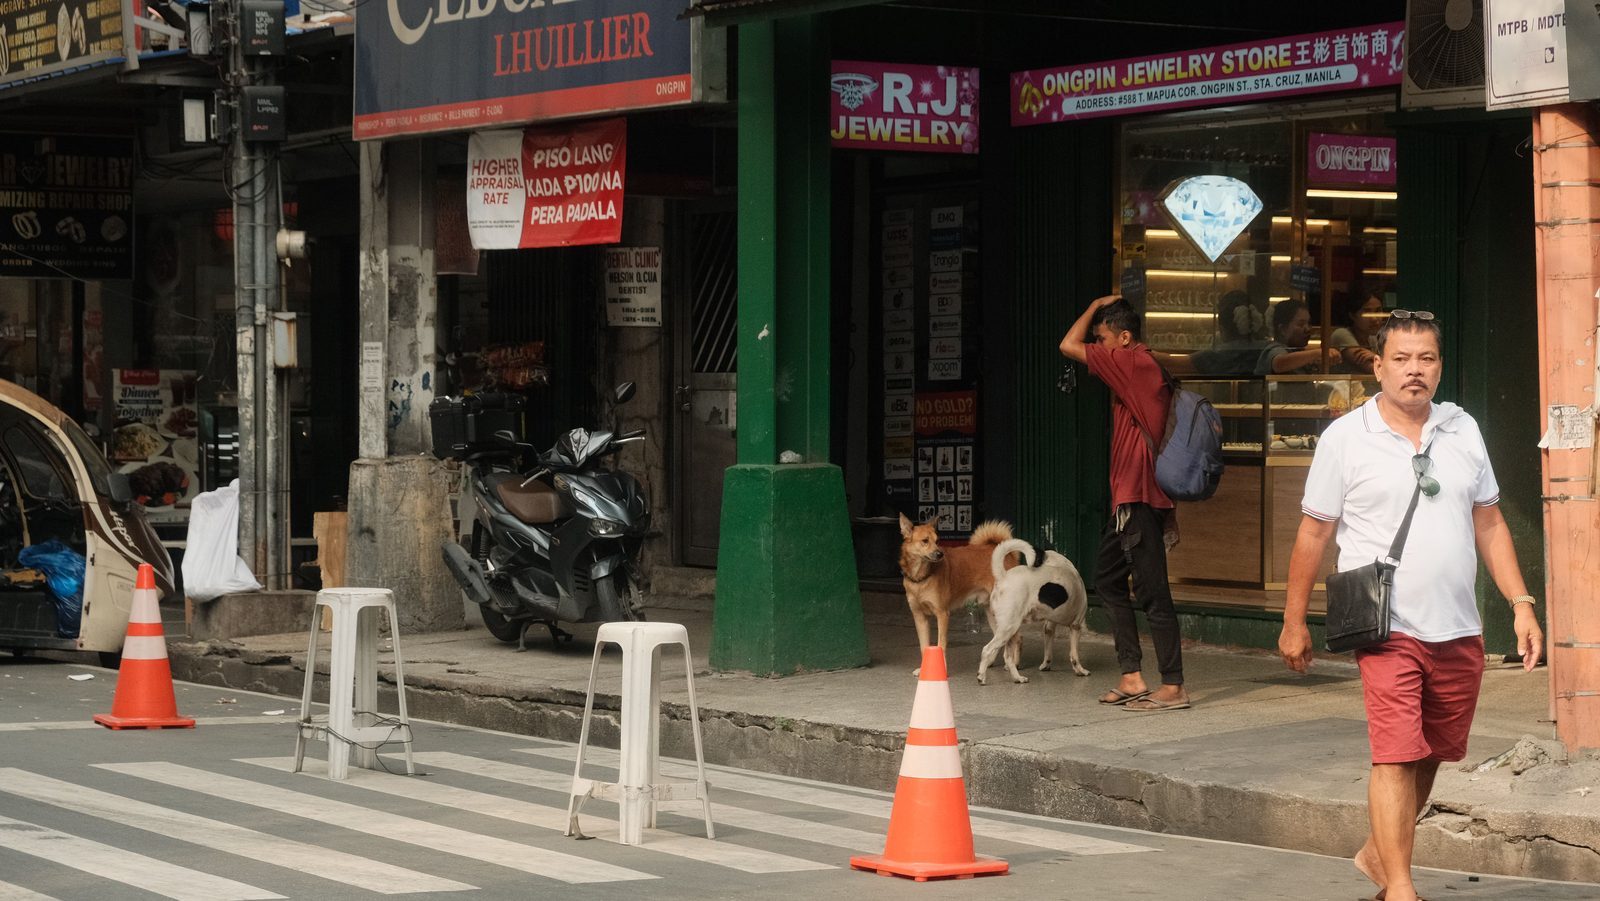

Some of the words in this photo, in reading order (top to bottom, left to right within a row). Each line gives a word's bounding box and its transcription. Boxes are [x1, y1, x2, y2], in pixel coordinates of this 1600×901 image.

[1498, 20, 1528, 37] MTPB
[493, 12, 654, 77] LHUILLIER
[1294, 29, 1389, 67] 王彬首饰商
[1042, 66, 1116, 96] ONGPIN
[1121, 52, 1216, 86] JEWELRY
[1221, 43, 1291, 74] STORE
[656, 81, 686, 96] ONGPIN
[882, 72, 971, 117] R.J.
[1075, 97, 1117, 110] ADDRESS:
[1118, 95, 1137, 105] #588
[1137, 93, 1146, 103] T.
[1147, 90, 1177, 102] MAPUA
[1178, 86, 1199, 97] COR.
[1200, 81, 1235, 95] ONGPIN
[1254, 77, 1274, 89] STA.
[1275, 73, 1303, 87] CRUZ,
[1305, 69, 1342, 83] MANILA
[830, 115, 969, 145] JEWELRY
[574, 143, 613, 166] LANG
[1316, 144, 1391, 173] ONGPIN
[471, 158, 519, 176] HIGHER
[470, 176, 524, 190] APPRAISAL
[526, 177, 563, 198] KADA
[600, 170, 623, 191] NA
[97, 192, 132, 210] SHOP
[483, 192, 509, 205] RATE
[530, 205, 563, 225] PERA
[566, 200, 617, 223] PADALA
[607, 252, 633, 268] DENTAL
[634, 250, 659, 268] CLINIC
[609, 271, 634, 283] NELSON
[643, 271, 658, 283] CUA
[618, 286, 647, 295] DENTIST
[932, 360, 959, 373] xoom
[121, 386, 160, 398] Dinner
[117, 404, 164, 420] Together
[916, 400, 933, 415] NO
[934, 397, 973, 414] GOLD?
[929, 414, 975, 428] PROBLEM!
